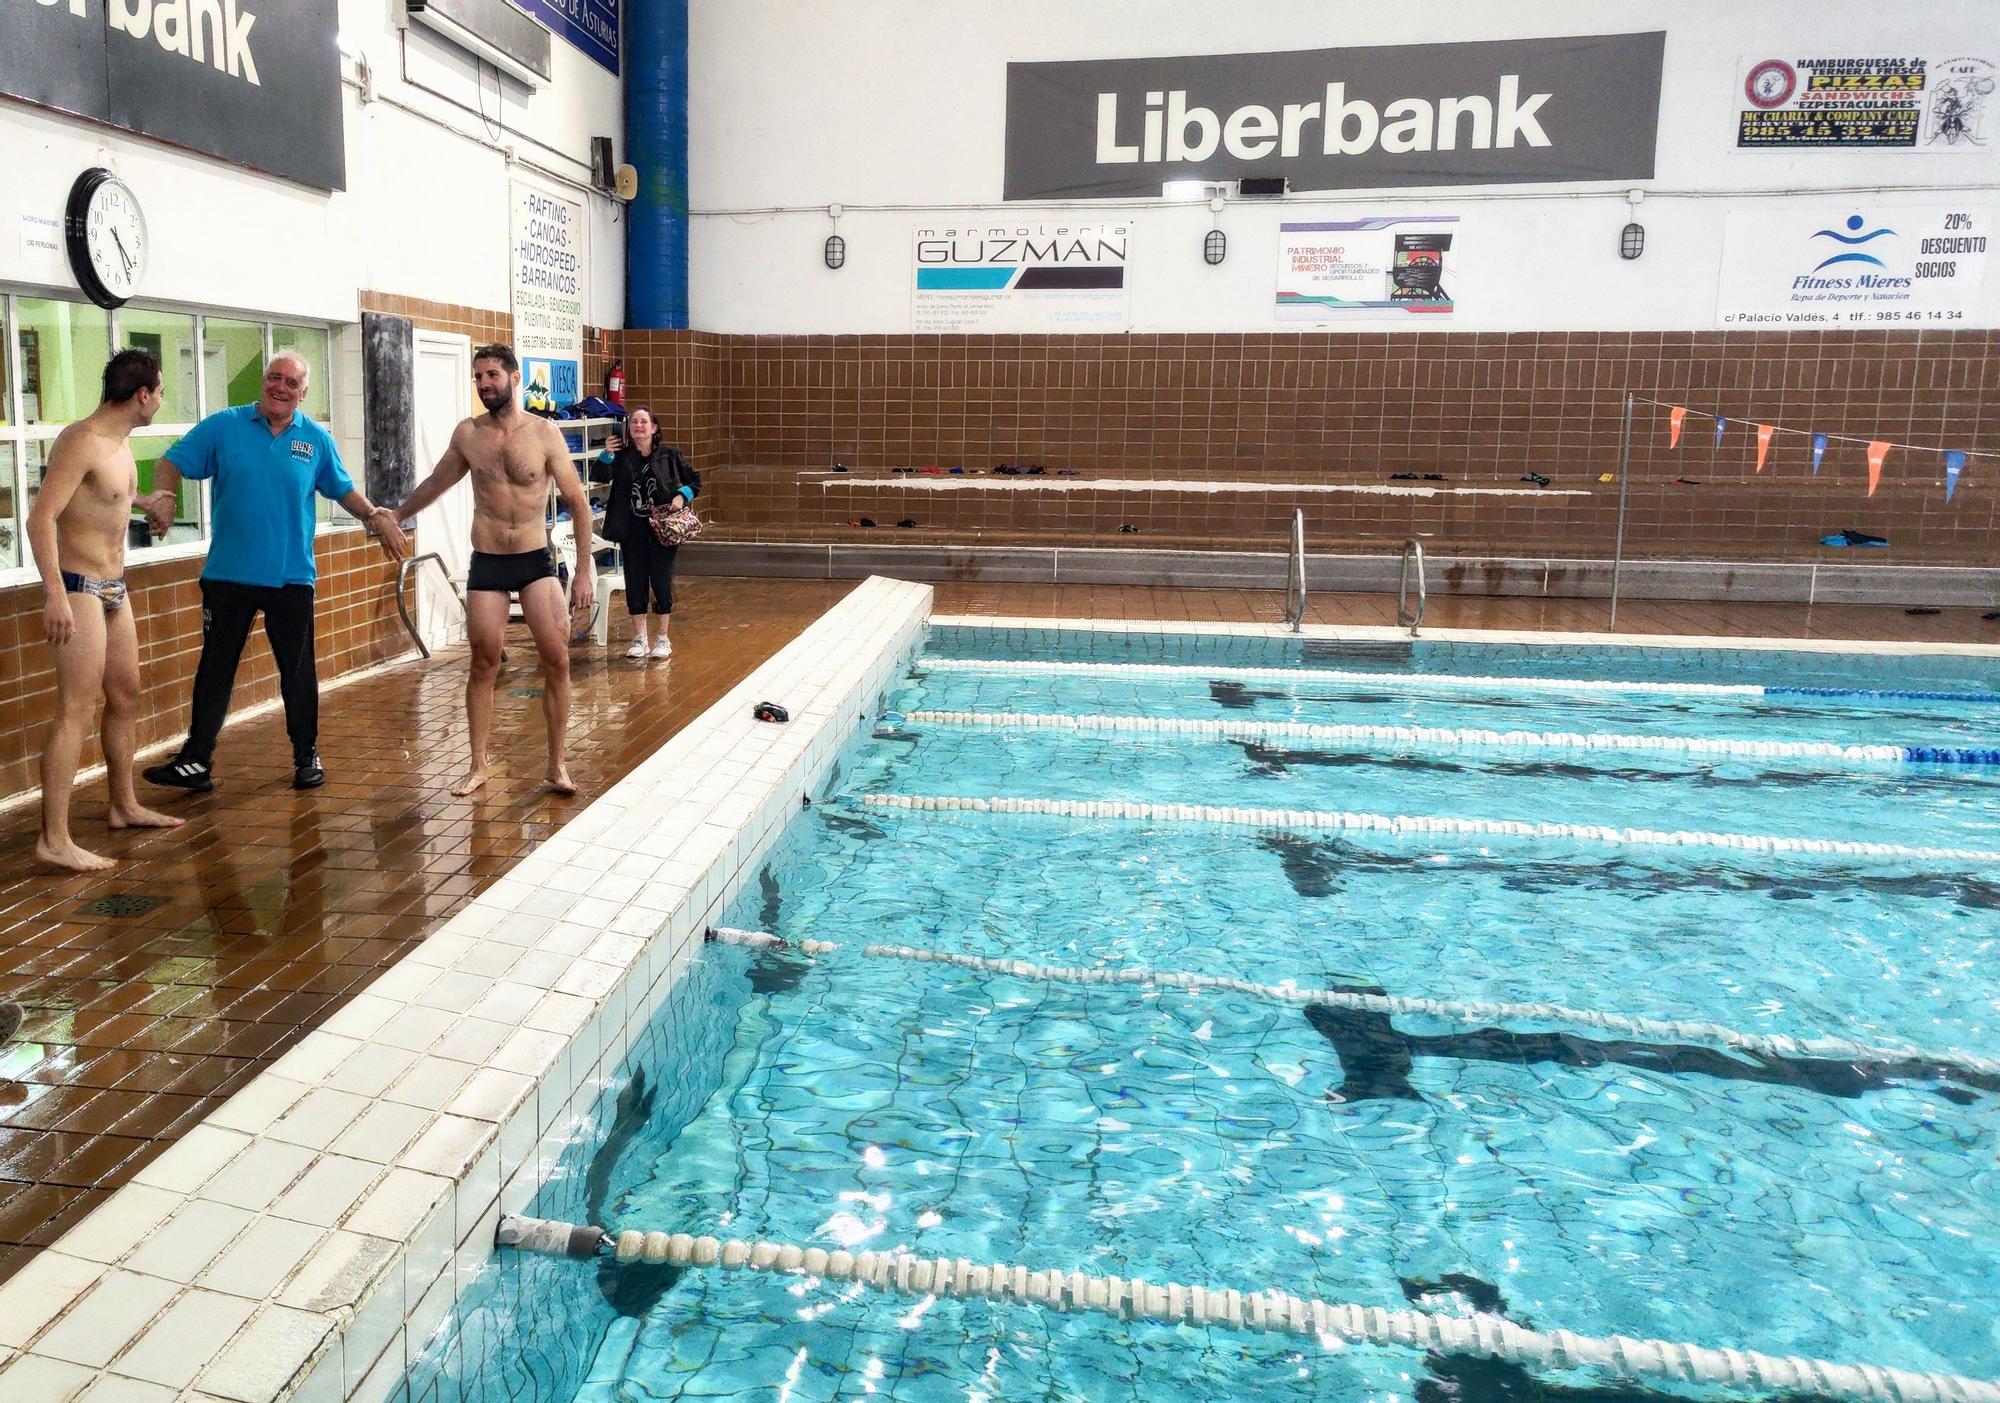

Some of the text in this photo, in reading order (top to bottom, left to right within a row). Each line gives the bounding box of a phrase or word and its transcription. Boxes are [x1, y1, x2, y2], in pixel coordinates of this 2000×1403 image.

[1797, 58, 1906, 69] HAMBURGUESAS
[1910, 56, 1927, 67] de
[1811, 67, 1925, 75] TERNERA FRESCA
[1811, 75, 1923, 87] PIZZAS
[1800, 92, 1916, 100] SANDWICHS
[1096, 75, 1554, 164] Liberbank
[1744, 112, 1760, 121] MC
[1763, 112, 1811, 121] CHARLY
[1814, 112, 1823, 121] &
[1826, 111, 1885, 121] COMPANY
[1744, 126, 1914, 136] 985 45 32 42
[529, 194, 567, 225] RAFTING
[1944, 213, 1972, 230] 20%
[530, 219, 567, 248] CANOAS
[917, 238, 1127, 263] GUZMAN
[1287, 246, 1345, 256] PATRIMONIO
[1921, 236, 1987, 255] DESCUENTO
[520, 240, 576, 273] HIDROSPEED
[1292, 255, 1344, 264] INDUSTRIAL
[1291, 263, 1328, 273] MINERO
[1915, 261, 1956, 278] SOCIOS
[521, 265, 576, 295] BARRANCOS
[1792, 274, 1912, 290] Fitness Mieres
[1790, 293, 1811, 303] Ropa
[1814, 292, 1826, 301] de
[1828, 292, 1863, 303] Deporte
[1724, 313, 1736, 322] c/
[1738, 313, 1782, 322] Palacio
[1832, 313, 1840, 321] 4
[1876, 311, 1901, 321] 985
[1905, 311, 1922, 320] 46
[1927, 311, 1942, 320] 14
[1946, 310, 1963, 320] 34
